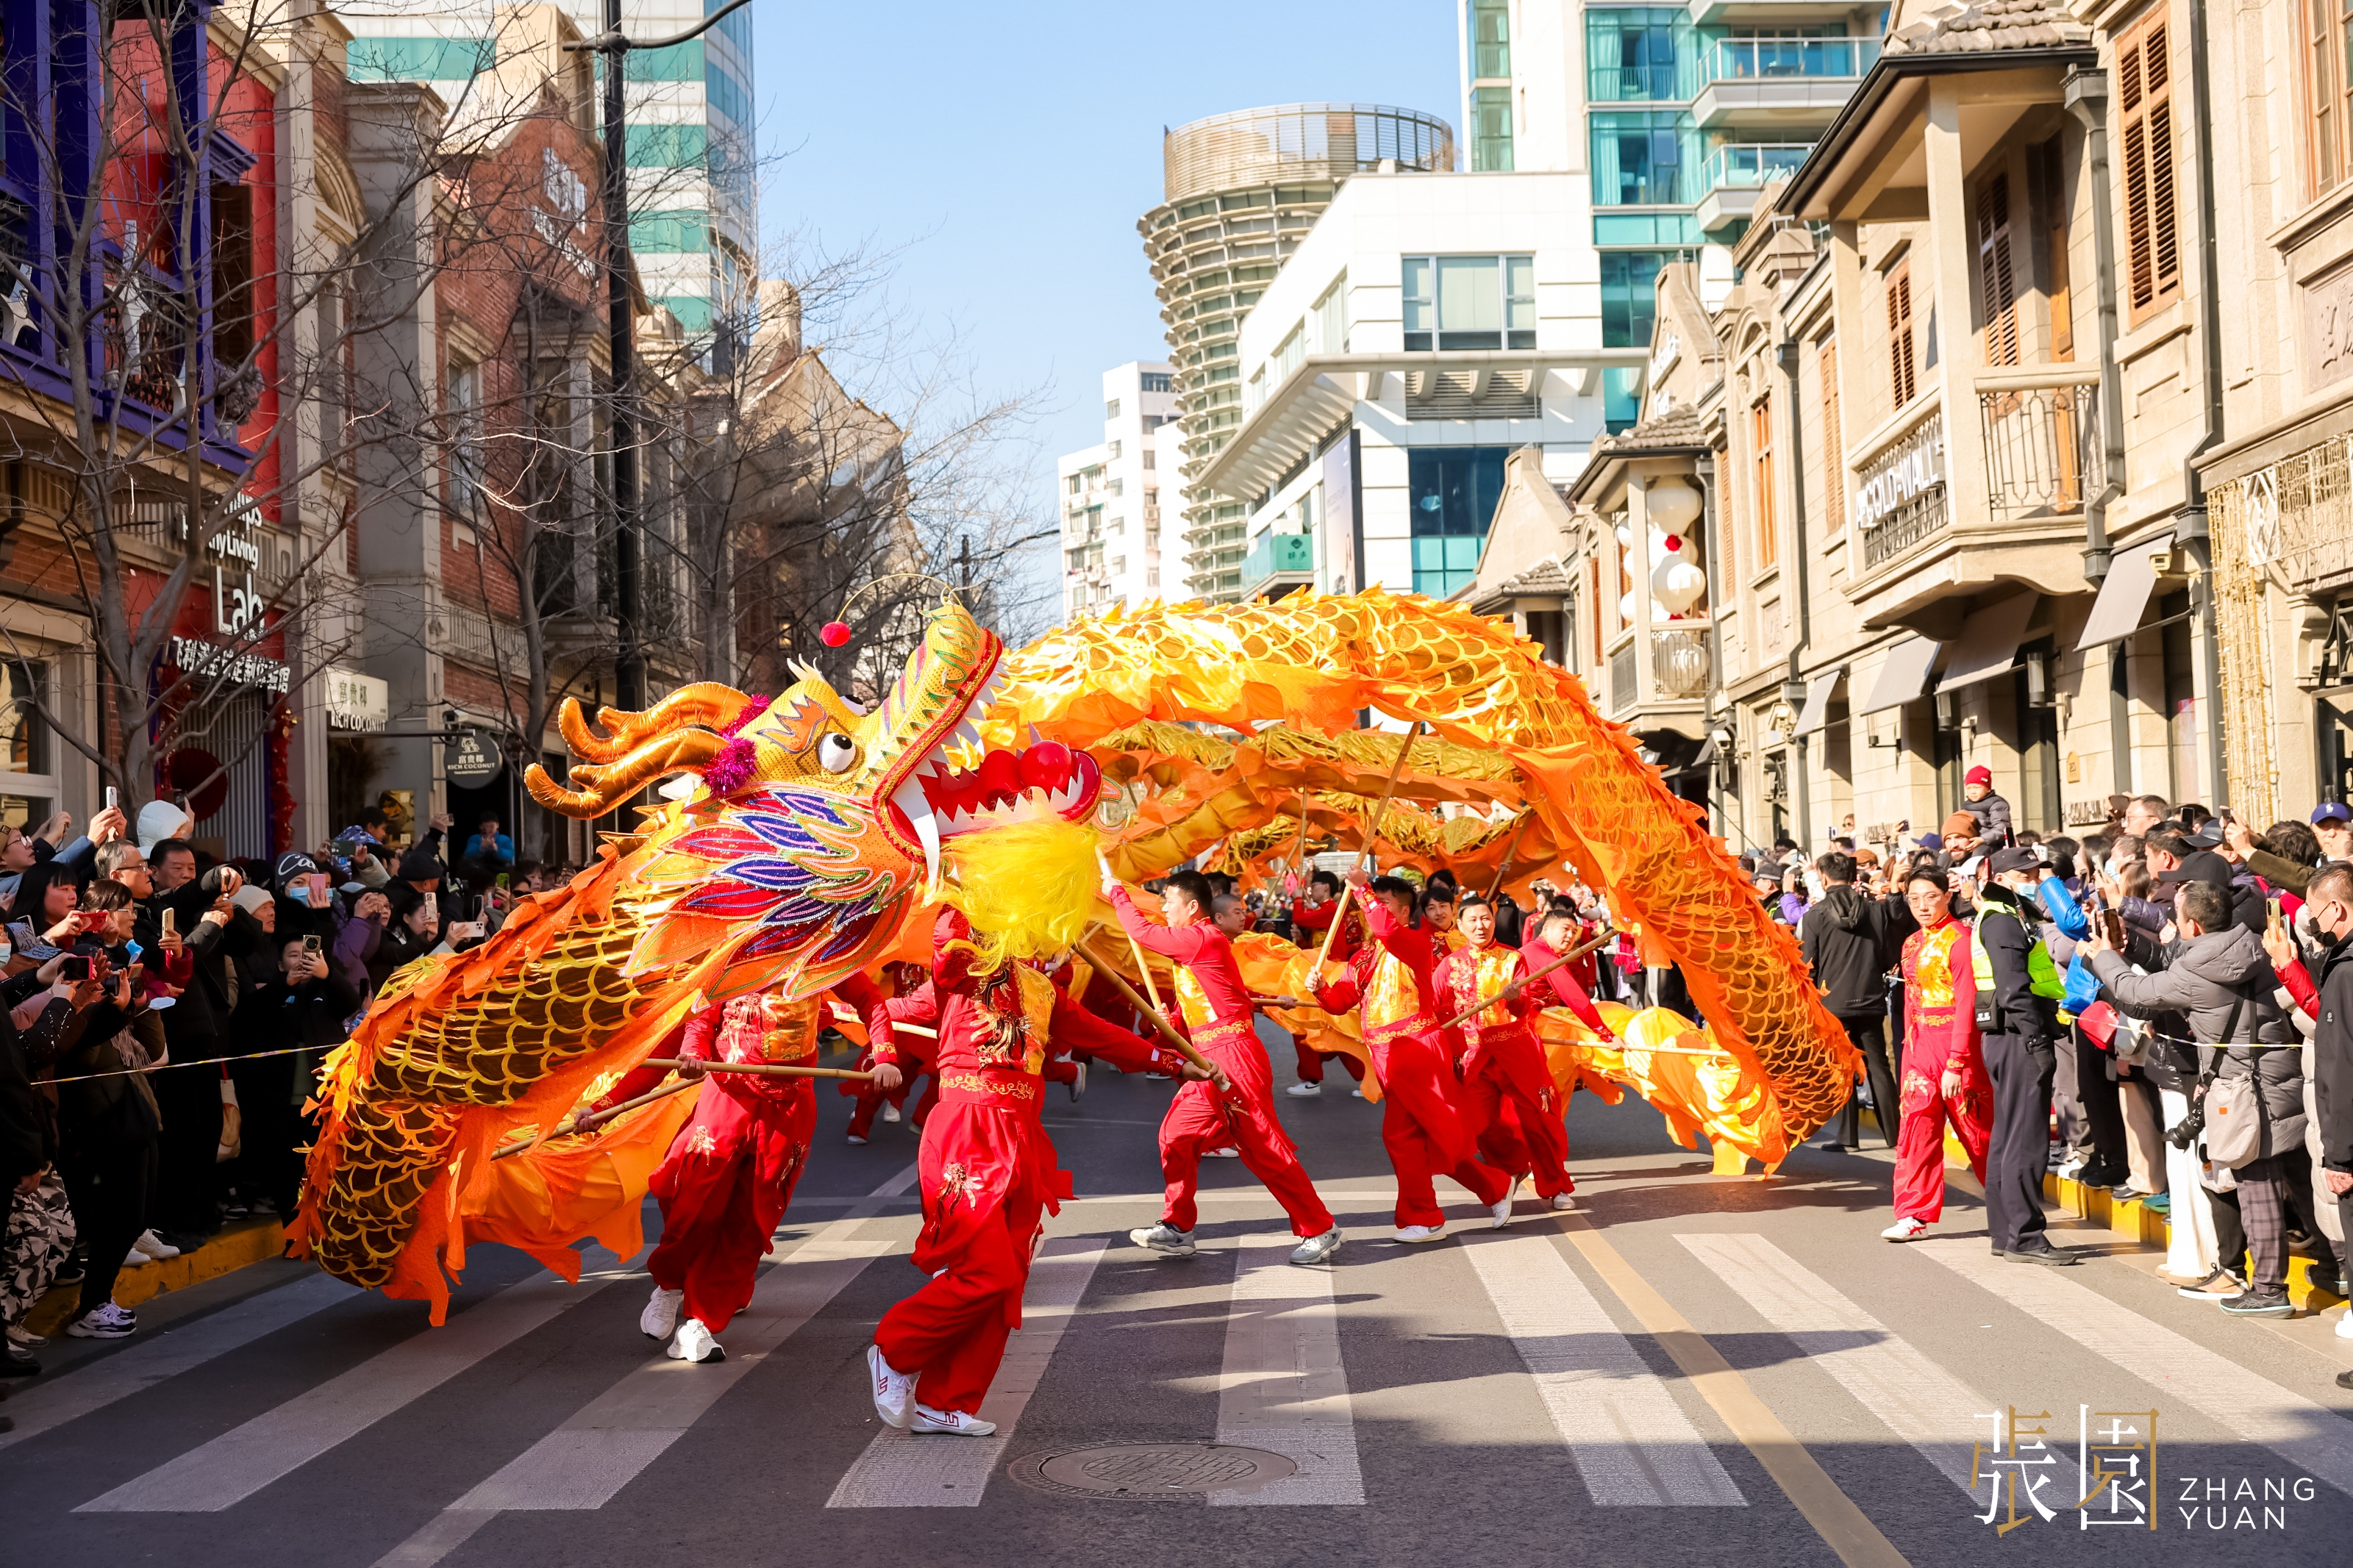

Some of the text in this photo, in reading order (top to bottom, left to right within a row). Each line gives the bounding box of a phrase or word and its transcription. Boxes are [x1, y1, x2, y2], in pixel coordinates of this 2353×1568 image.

[217, 565, 265, 644] Lab
[332, 712, 385, 731] RICH COCONUT
